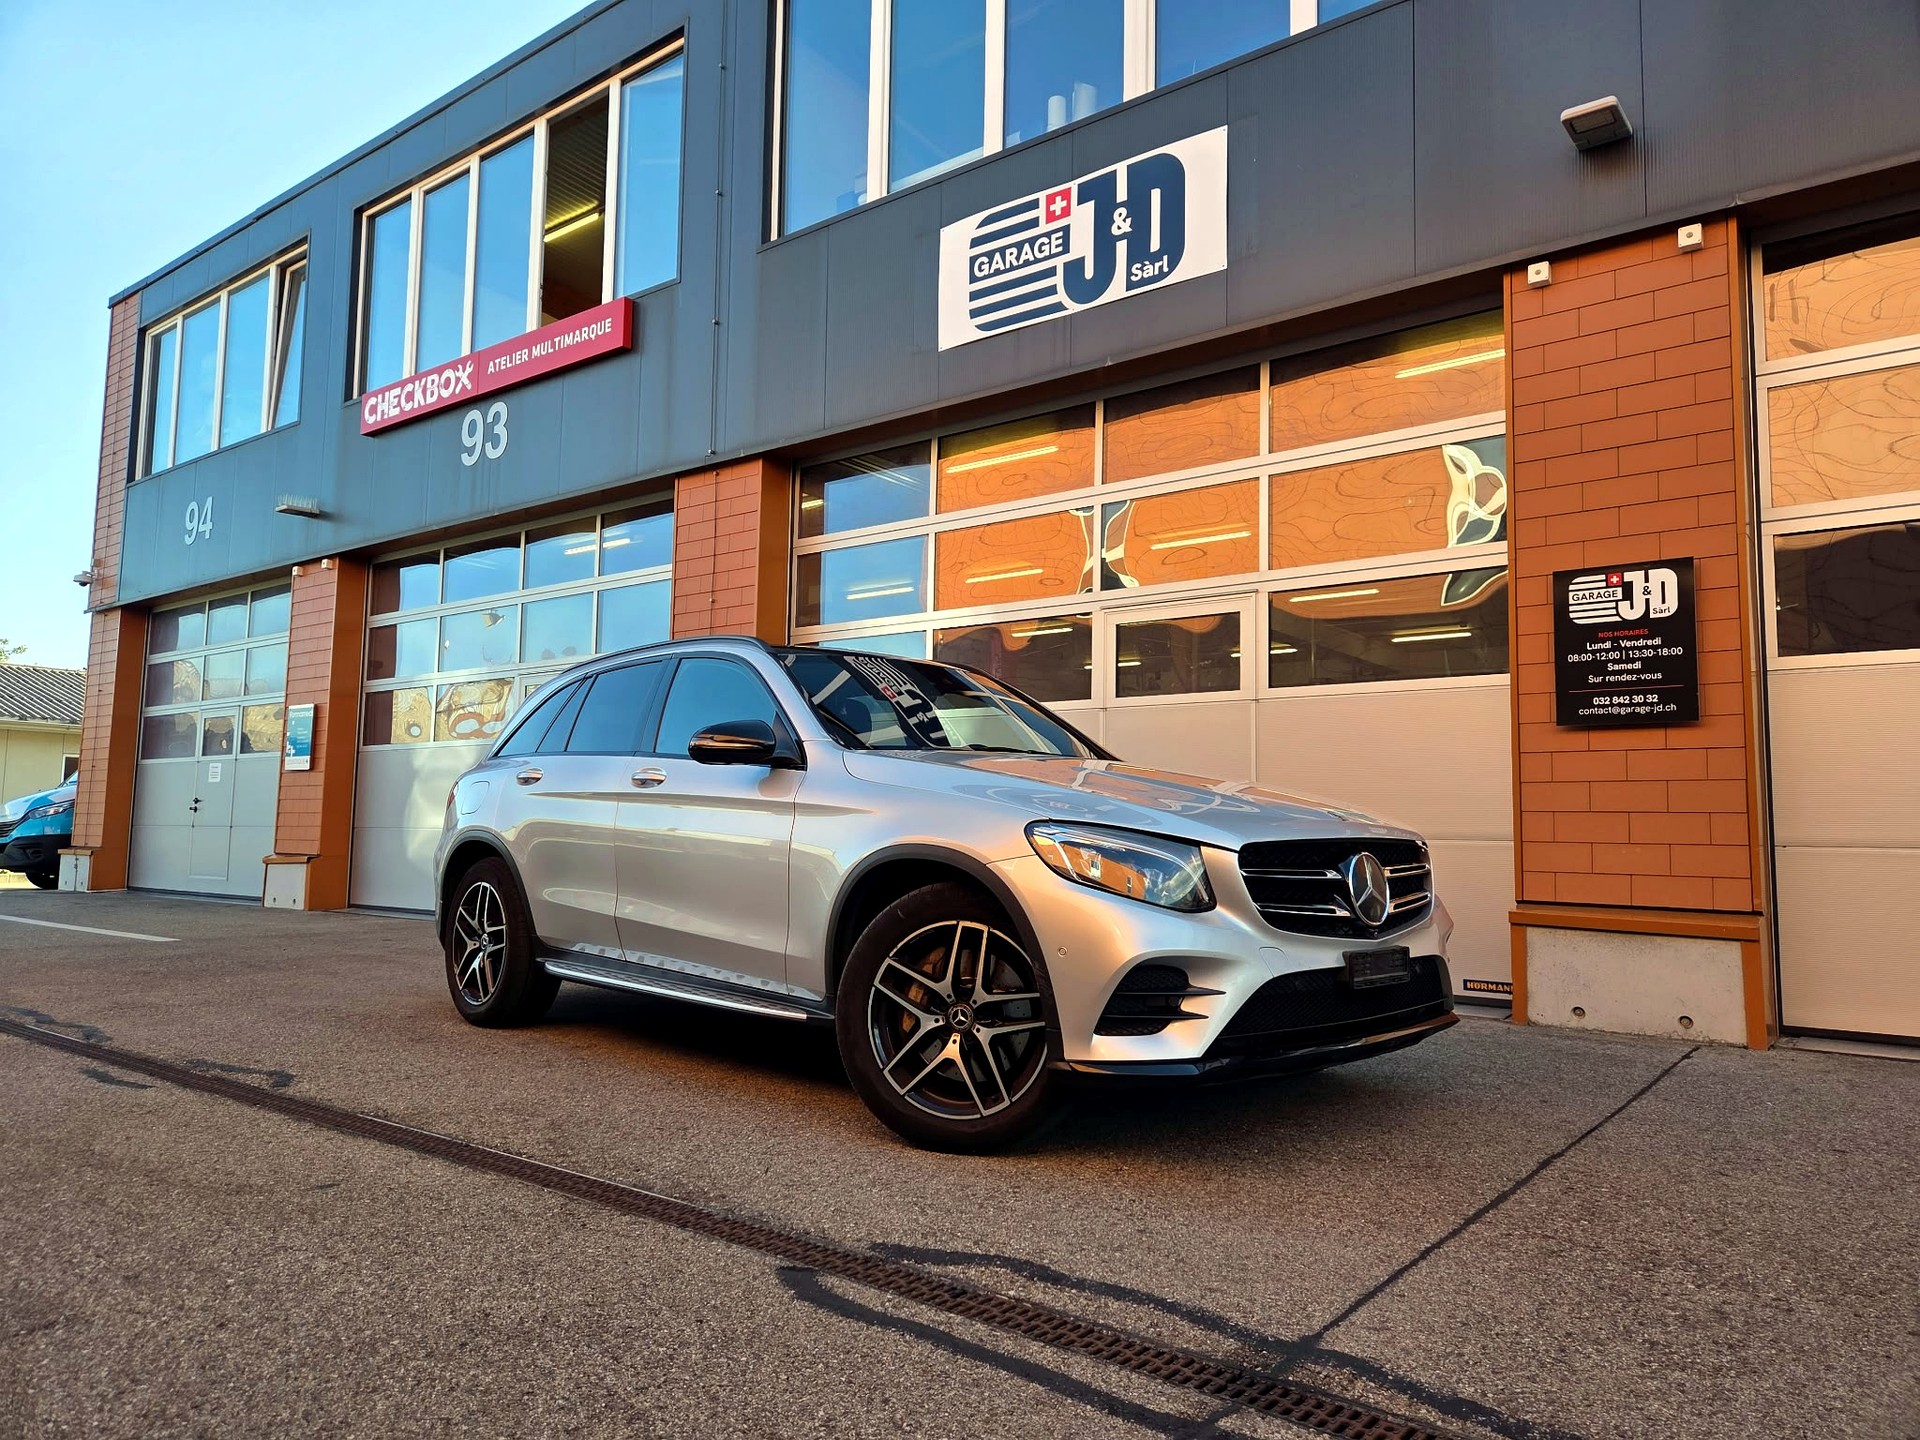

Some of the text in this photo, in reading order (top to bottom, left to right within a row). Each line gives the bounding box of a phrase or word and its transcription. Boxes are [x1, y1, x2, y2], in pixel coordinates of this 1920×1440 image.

[973, 231, 1063, 278] GARAGE
[1130, 254, 1169, 282] Sàrl
[364, 317, 612, 424] CHECKBOX ATELIER MULTIMARQUE
[460, 401, 509, 467] 93
[184, 495, 213, 546] 94
[1571, 589, 1619, 602] GARAGE
[1614, 629, 1649, 637] HORAIRES
[1586, 640, 1612, 651] Lundi
[1619, 637, 1662, 648] Vendredi
[1567, 651, 1620, 663] 08:00-12:00
[1628, 646, 1683, 659] 13:30-18:00
[1607, 661, 1642, 671] Samedi
[1588, 672, 1663, 683] Sur rendez-vous
[1593, 694, 1659, 705] 032 842 30 32
[1578, 703, 1677, 716] contact@garage-jd.ch
